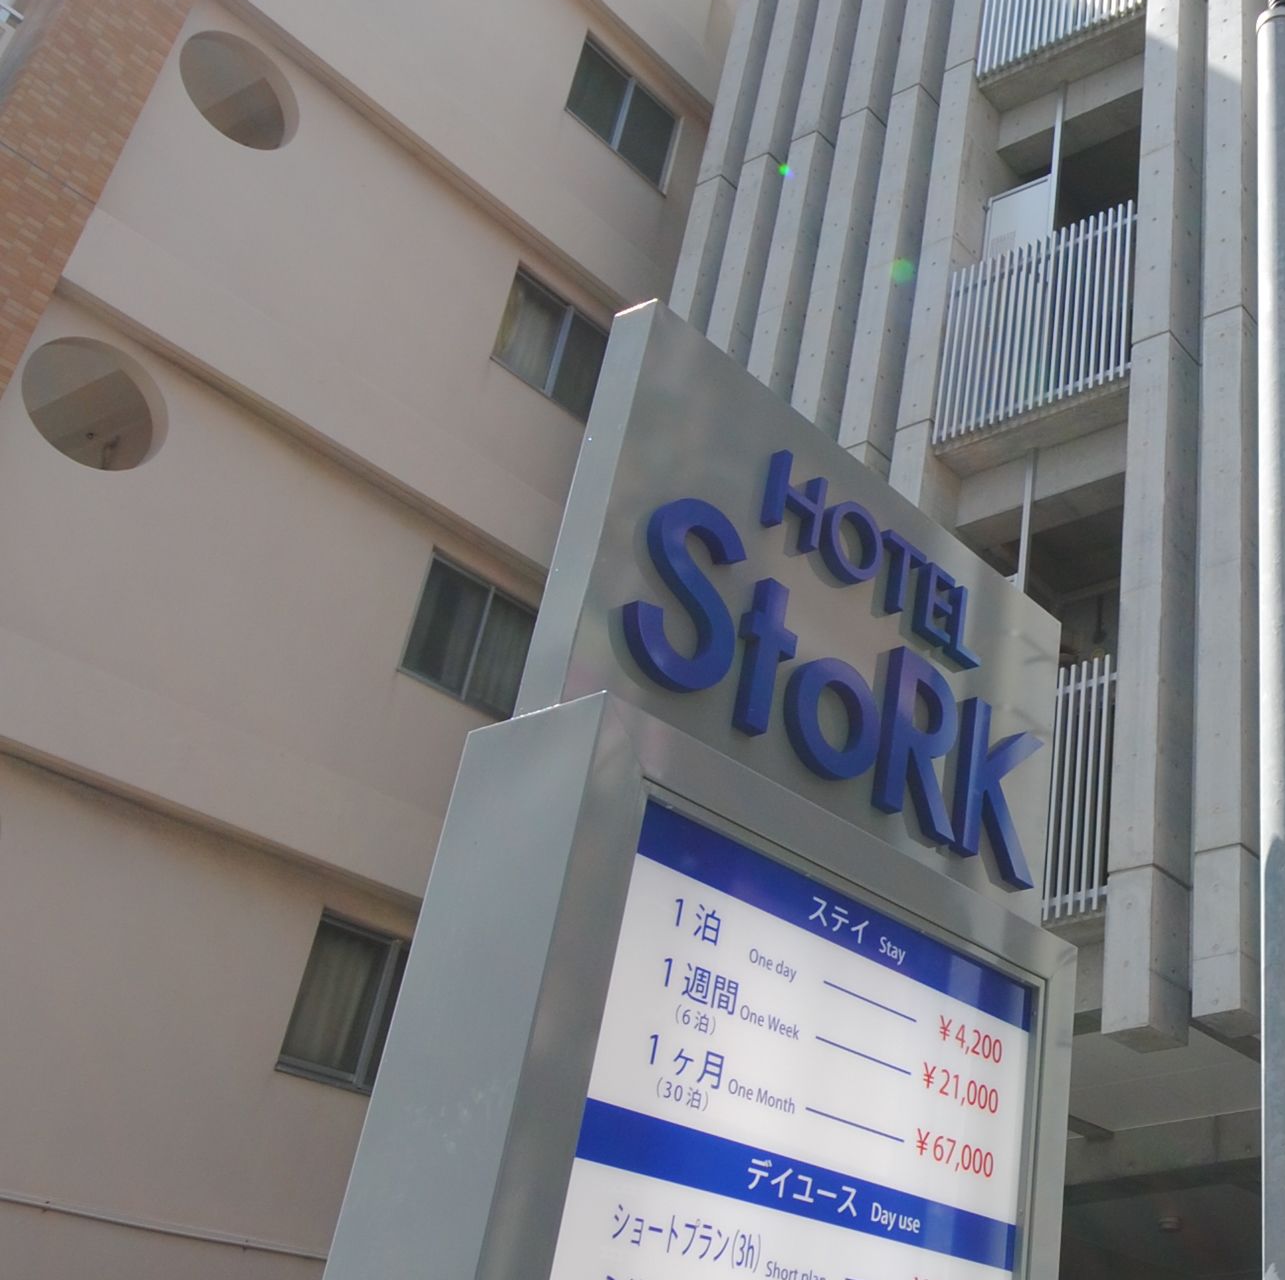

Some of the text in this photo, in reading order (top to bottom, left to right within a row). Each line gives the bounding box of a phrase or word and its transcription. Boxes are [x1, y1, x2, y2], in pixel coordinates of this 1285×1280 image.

[760, 449, 982, 669] HOTEL
[809, 896, 906, 966] ステイ Stay
[674, 1004, 716, 1036] (6泊)
[749, 948, 773, 970] One
[775, 961, 797, 983] day
[939, 1015, 1003, 1064] ¥4,200
[656, 1077, 710, 1112] (30泊)
[740, 1004, 765, 1026] One
[767, 1014, 799, 1040] Week
[922, 1062, 999, 1114] ¥21,000
[728, 1079, 755, 1098] One
[756, 1088, 796, 1114] Month
[916, 1128, 994, 1178] ¥67,000
[747, 1158, 921, 1234] デイユース Day use
